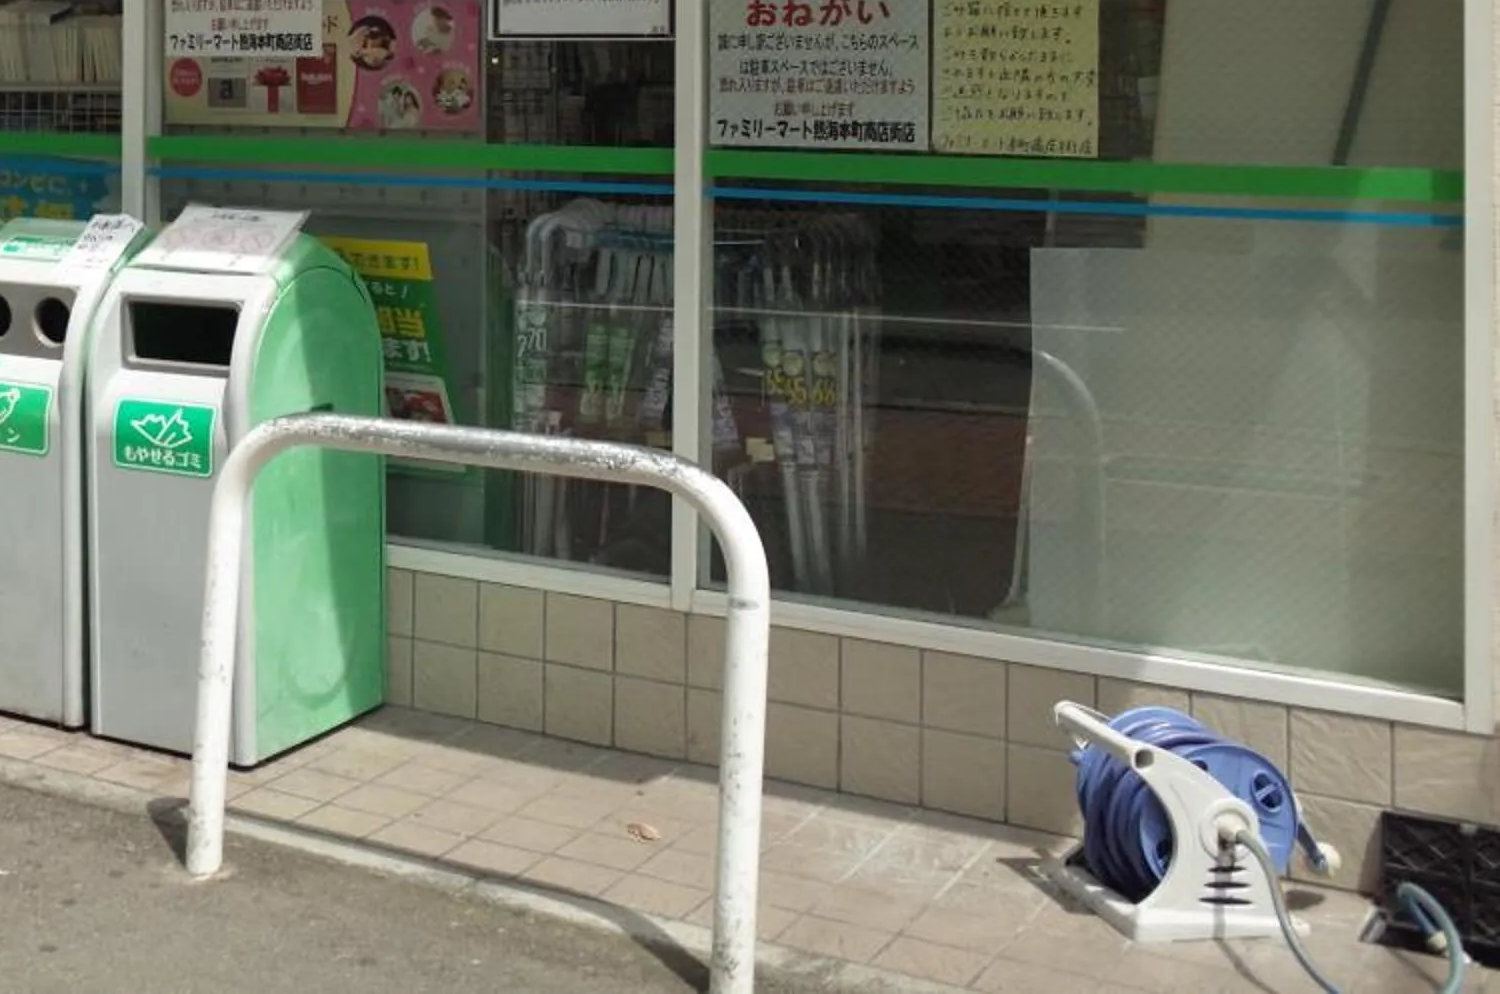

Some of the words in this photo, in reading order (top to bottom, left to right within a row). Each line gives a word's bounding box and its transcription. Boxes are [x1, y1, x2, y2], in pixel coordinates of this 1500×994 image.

[122, 445, 202, 469] もやせるゴミ
